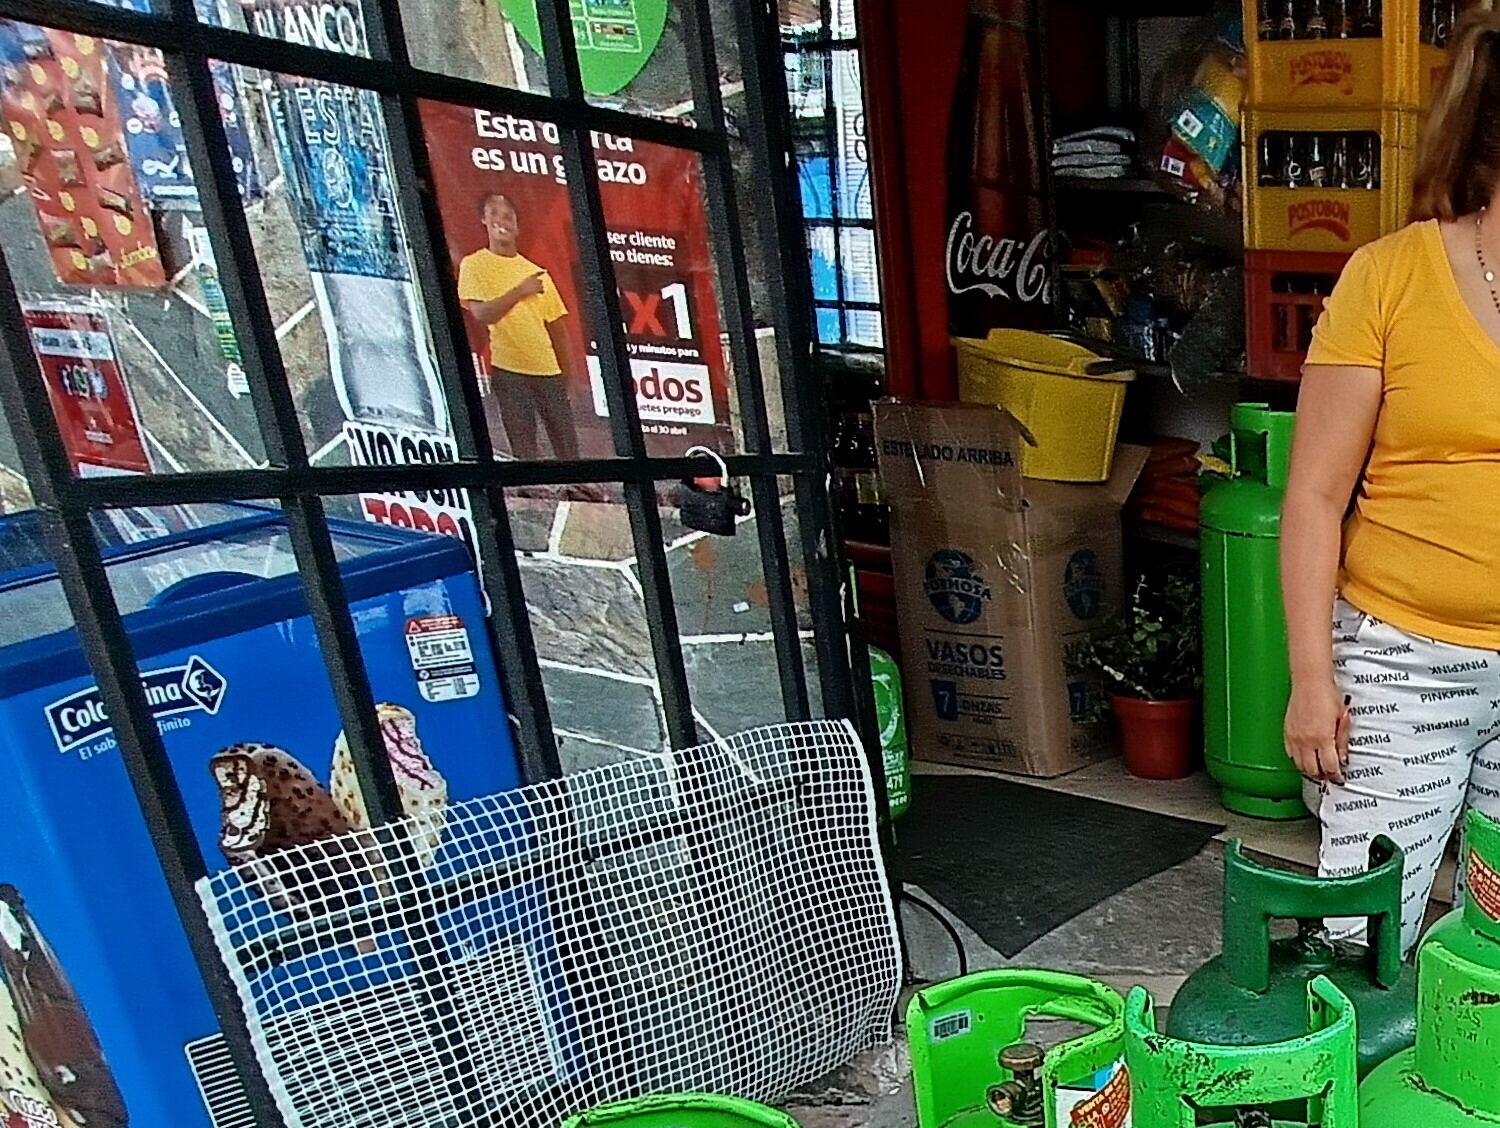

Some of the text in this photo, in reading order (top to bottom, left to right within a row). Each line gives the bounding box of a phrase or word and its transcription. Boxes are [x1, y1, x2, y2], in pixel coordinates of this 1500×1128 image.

[474, 108, 634, 153] Esta orta
[472, 147, 648, 186] es un gazo
[629, 231, 676, 249] cliente
[626, 248, 675, 266] tienes:
[946, 210, 1051, 304] Coca-C
[617, 282, 693, 340] x1
[638, 343, 677, 357] minutos
[677, 345, 699, 358] para
[634, 367, 704, 404] dos
[957, 446, 1015, 468] ARRIBA
[925, 638, 1004, 668] VASOS
[1353, 671, 1411, 685] PINKPINK
[1427, 659, 1489, 677] PINKPINK
[1420, 686, 1480, 704] PINKPINK
[60, 681, 184, 733] Colina
[93, 736, 118, 755] sab
[156, 716, 192, 736] finito
[1412, 718, 1471, 735] PINKPINK
[1402, 745, 1458, 767] PINKPINK
[1396, 776, 1452, 798] PINKPINK
[1388, 806, 1443, 832] PINKPINK
